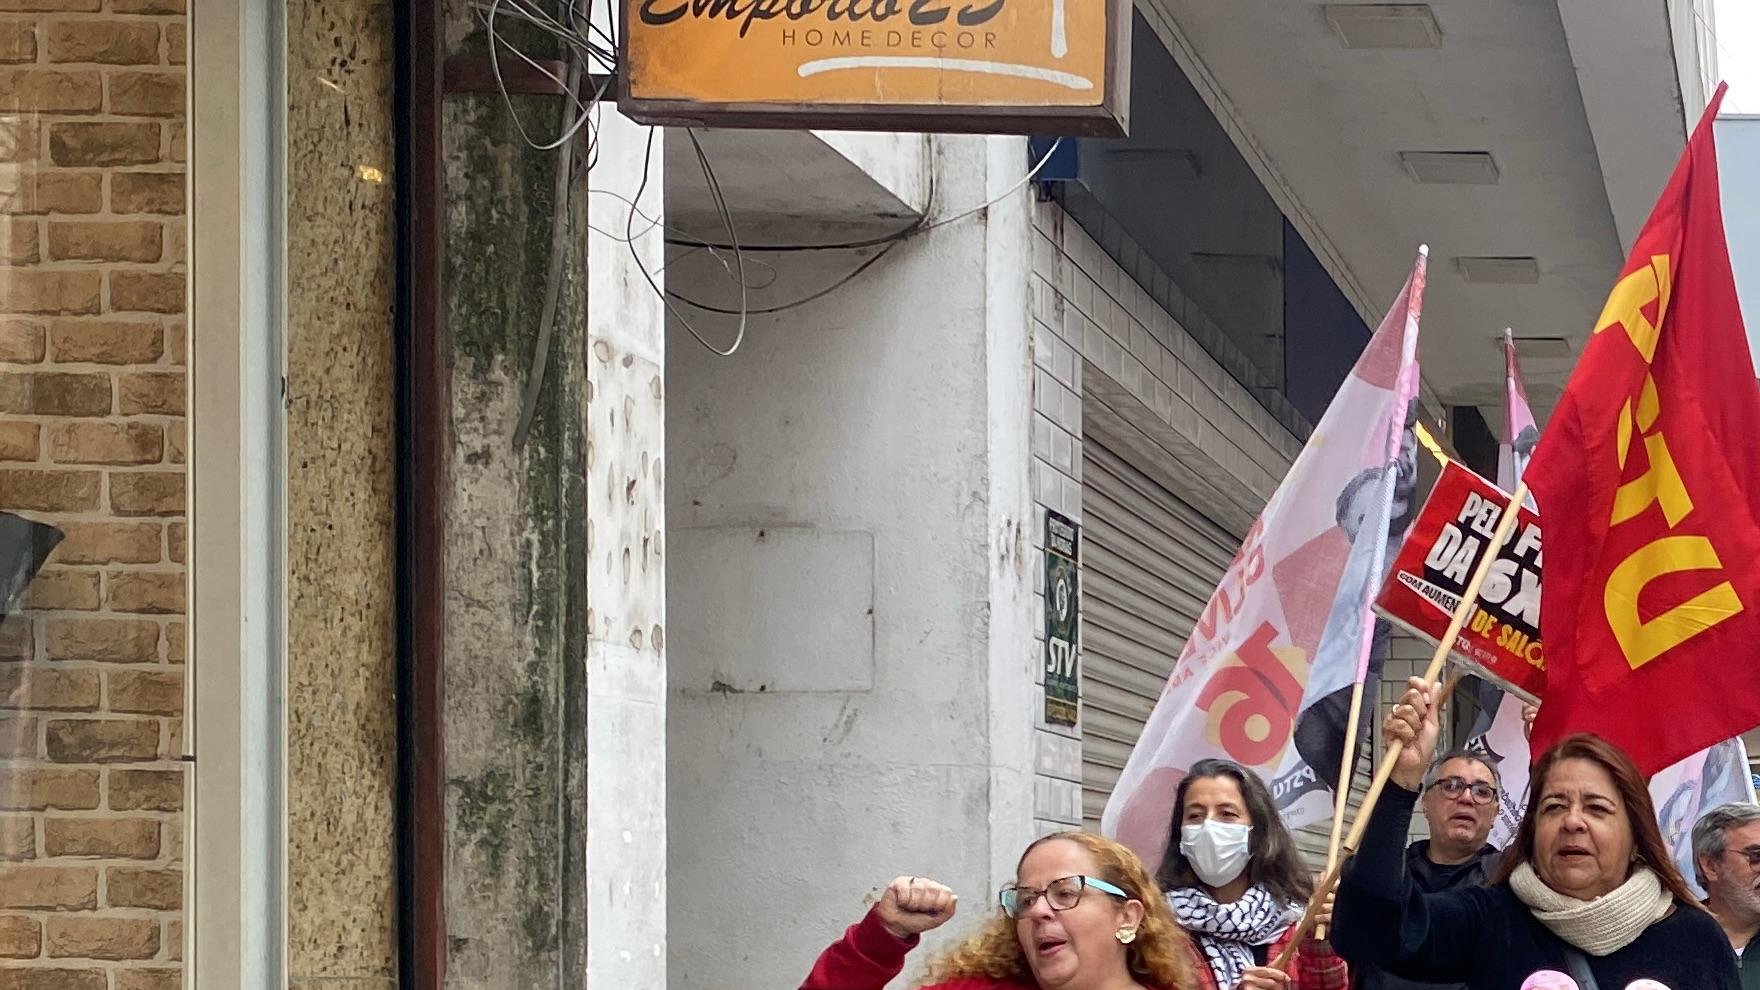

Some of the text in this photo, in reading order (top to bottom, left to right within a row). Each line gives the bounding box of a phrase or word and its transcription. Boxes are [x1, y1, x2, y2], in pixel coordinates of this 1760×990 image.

[782, 29, 997, 48] HOME DECOR
[1424, 522, 1480, 586] DA
[1400, 573, 1423, 590] COM
[1471, 609, 1498, 638] DE
[1047, 636, 1077, 678] STV
